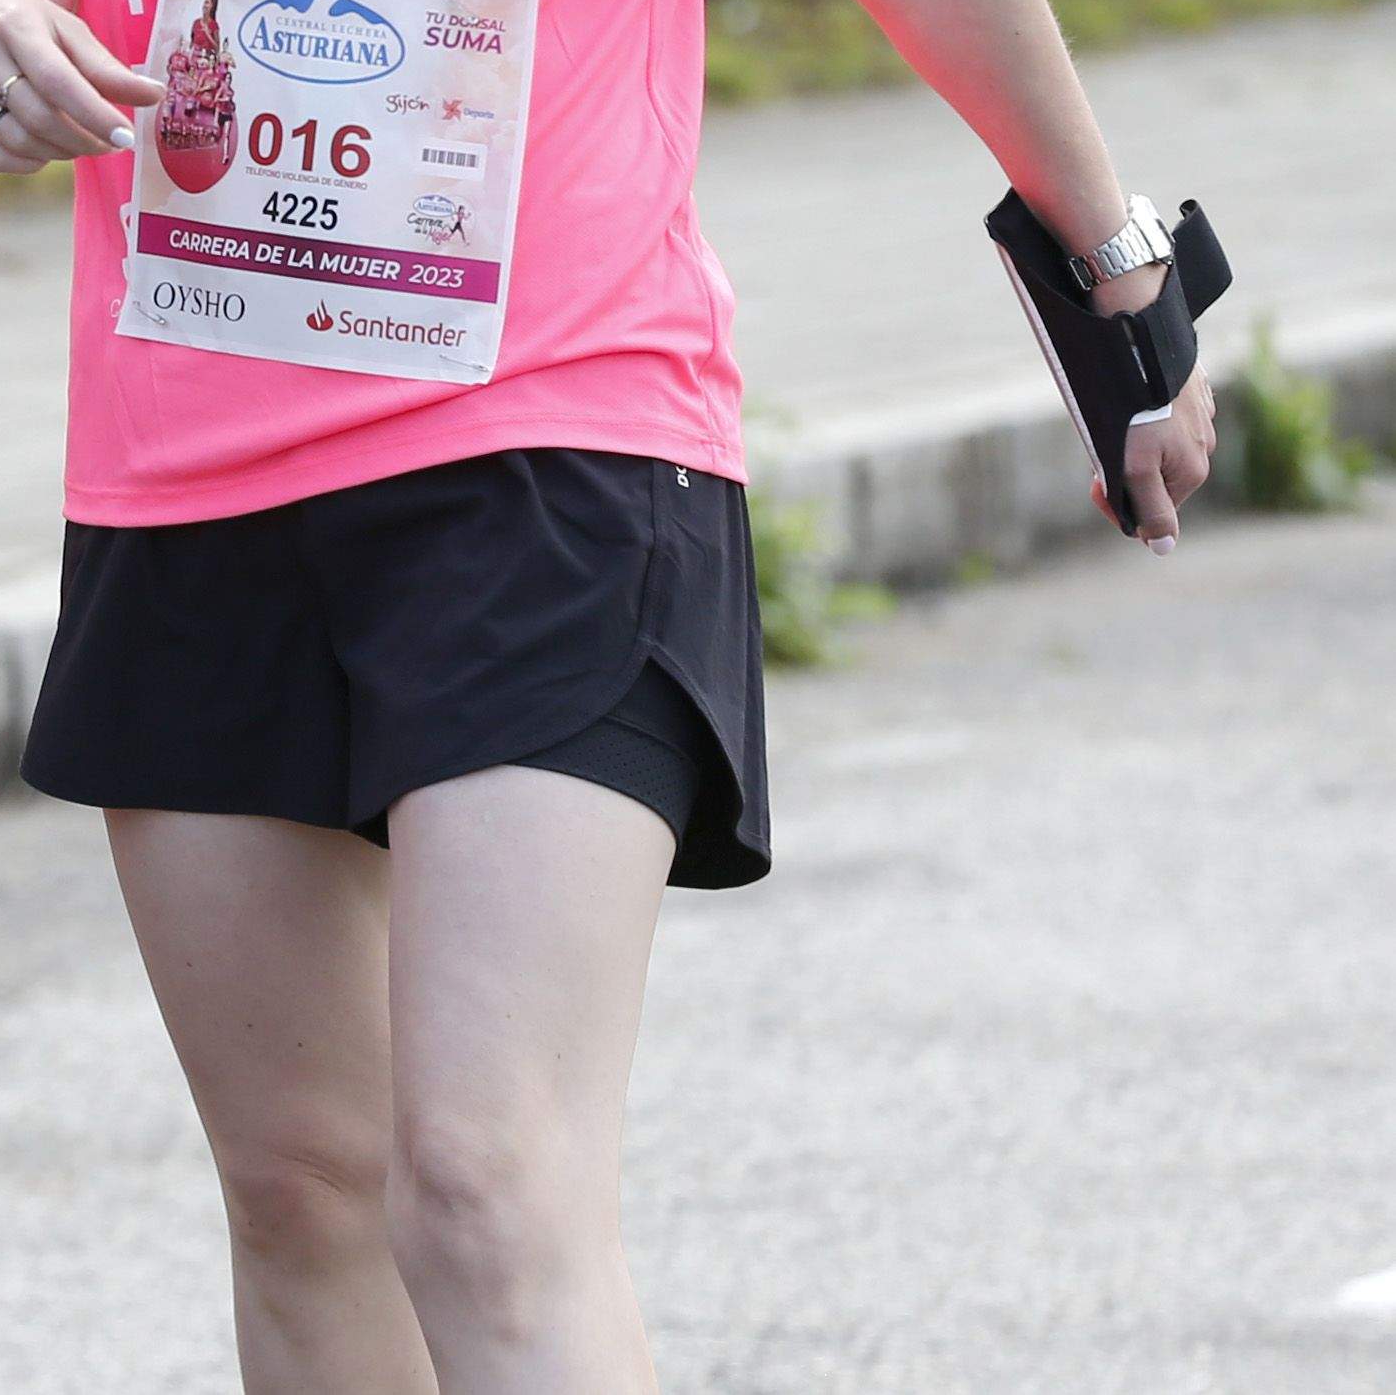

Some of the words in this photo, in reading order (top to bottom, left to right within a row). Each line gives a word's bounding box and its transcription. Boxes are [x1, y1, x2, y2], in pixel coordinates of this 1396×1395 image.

[276, 16, 326, 31] CENTRAL
[426, 11, 445, 24] TU
[249, 16, 389, 66] ASTURIANA
[424, 27, 502, 54] SUMA
[248, 113, 371, 178] 016
[282, 172, 320, 185] VIOLENCIA
[321, 178, 332, 186] DE
[262, 191, 339, 231] 4225
[169, 228, 250, 259] CARRERA
[255, 242, 285, 266] DE
[287, 247, 314, 270] LA
[319, 252, 400, 282] MUJER
[408, 264, 465, 289] 2023
[153, 281, 246, 323] OYSHO
[338, 311, 466, 347] Santander
